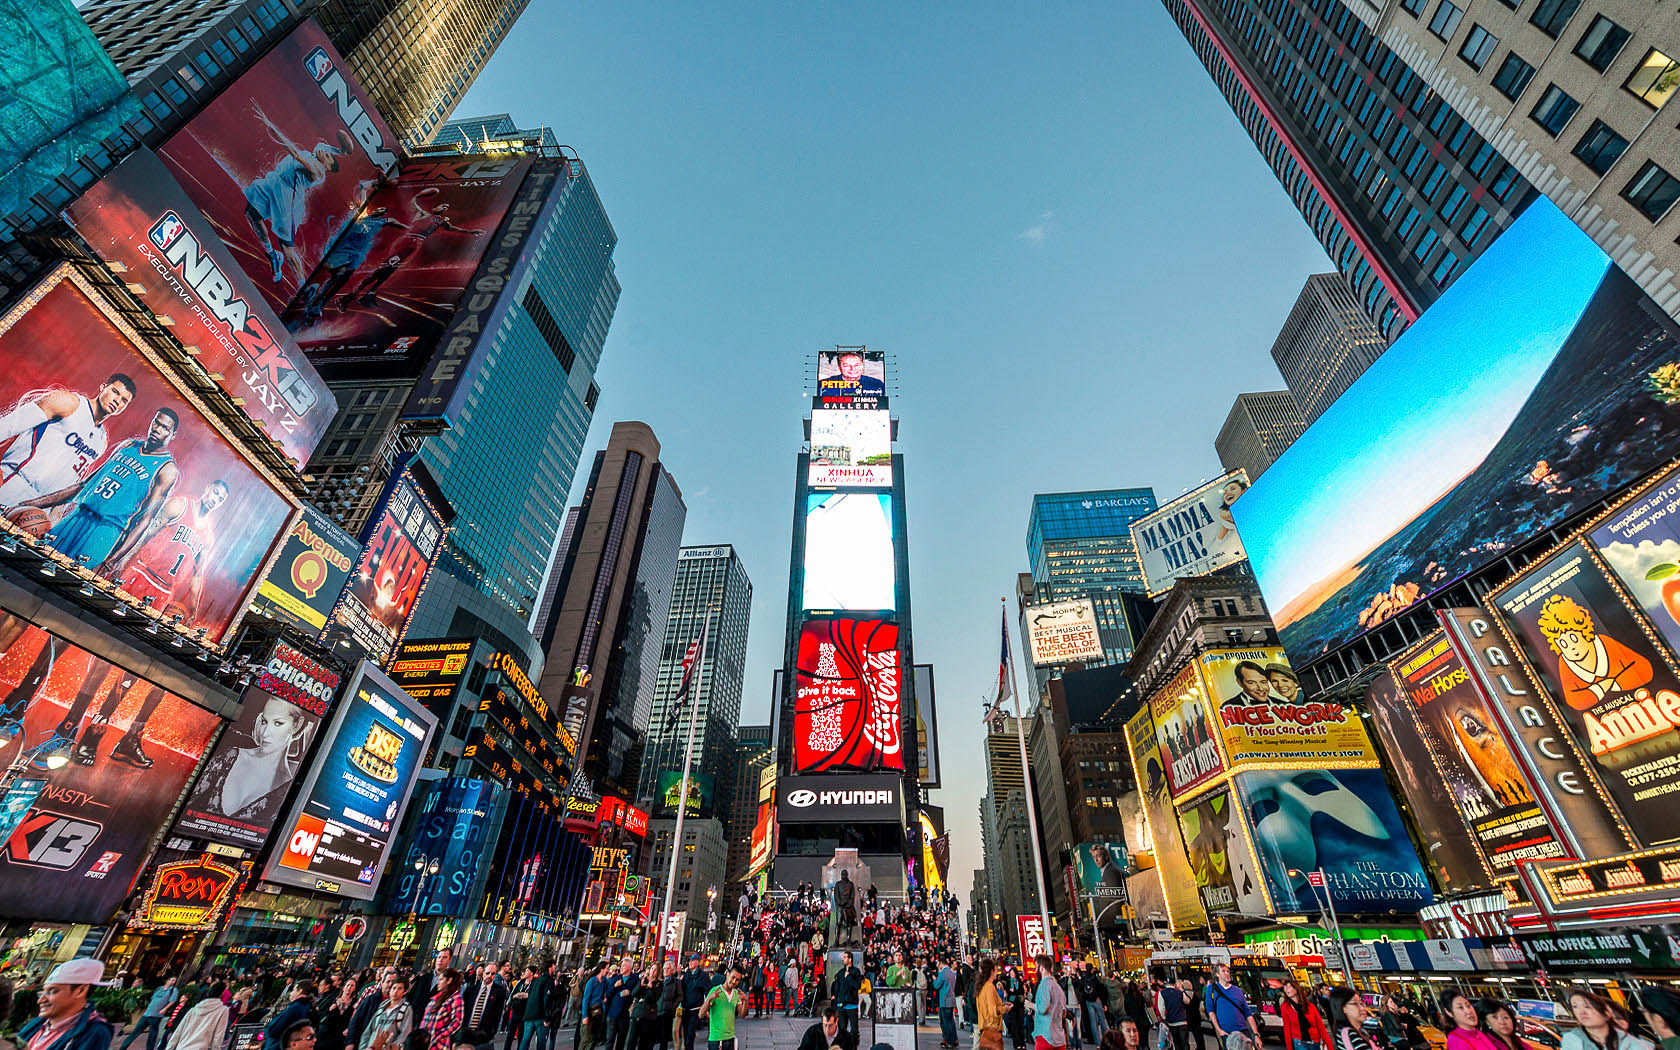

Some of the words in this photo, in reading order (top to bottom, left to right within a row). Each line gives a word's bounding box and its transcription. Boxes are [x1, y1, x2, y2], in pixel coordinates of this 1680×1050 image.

[500, 173, 555, 248] TIMES
[137, 243, 194, 305] EXECUTIVE
[191, 304, 238, 358] PRODUCED
[234, 355, 250, 369] BY
[430, 257, 511, 381] SQUARE
[822, 380, 850, 389] PETER
[241, 369, 285, 415] JAY
[279, 414, 301, 434] Z
[417, 397, 443, 405] NYC
[111, 464, 133, 480] CITY
[828, 468, 874, 477] XINHUA
[94, 476, 122, 501] 35
[1095, 496, 1149, 508] BARCLAYS
[1607, 503, 1651, 534] Temptation
[1648, 490, 1668, 507] isn't
[1667, 487, 1677, 495] a
[1140, 501, 1215, 554] MAMMA
[1622, 519, 1650, 538] Unless
[1648, 508, 1667, 525] you
[291, 519, 352, 573] Avenue
[683, 550, 713, 558] Allianz
[1161, 530, 1208, 573] MIA!
[168, 553, 185, 576] 1
[290, 550, 328, 600] Q
[1034, 629, 1054, 637] BEST
[1056, 625, 1093, 634] MUSICAL
[1036, 635, 1060, 646] THE
[1062, 631, 1093, 643] BEST
[403, 643, 440, 653] THOMSON
[439, 642, 471, 652] REUTERS
[1037, 642, 1080, 653] MUSICAL
[1224, 650, 1268, 661] BRODERICK
[276, 643, 339, 688] CHICAGO
[397, 661, 441, 670] COMMODITIES
[403, 670, 430, 678] ENERGY
[267, 658, 333, 702] CHICAGO
[501, 653, 538, 707] CONFERENCE
[1153, 691, 1168, 708] THE
[1167, 666, 1196, 698] CROWD
[797, 686, 819, 699] give
[821, 685, 831, 695] it
[832, 685, 856, 697] back
[1155, 699, 1176, 719] GOES
[1220, 703, 1275, 728] NICE
[1272, 701, 1348, 726] WORK
[1469, 617, 1585, 794] PALACE
[1591, 705, 1605, 717] THE
[1604, 693, 1634, 712] MUSICAL
[1245, 725, 1255, 737] If
[1257, 725, 1276, 737] You
[1276, 724, 1296, 736] Can
[1296, 725, 1315, 736] Get
[1317, 724, 1327, 735] It
[1582, 687, 1680, 756] Annie
[366, 726, 403, 764] DISH
[1339, 750, 1364, 758] STORY
[1171, 751, 1201, 790] JERSEY
[1195, 738, 1220, 775] BOYS
[566, 797, 598, 813] Reese's
[819, 790, 893, 805] HYUNDAI
[1490, 850, 1515, 865] LINCOLN
[1513, 845, 1538, 860] CENTER
[1354, 861, 1381, 872] THE
[161, 869, 226, 901] ROXY
[1326, 871, 1427, 889] PHANTOM
[1559, 873, 1595, 895] Annie
[1604, 865, 1646, 889] Annie
[1334, 889, 1351, 901] OF
[1353, 889, 1381, 901] THE
[1380, 889, 1423, 901] OPERA
[155, 905, 203, 923] DELICATESSEN
[228, 946, 246, 955] BLUE
[1272, 939, 1296, 957] sbarro
[1491, 942, 1527, 964] Annie
[1532, 938, 1558, 953] BOX
[1557, 936, 1598, 951] OFFICE
[1595, 933, 1632, 949] HERE
